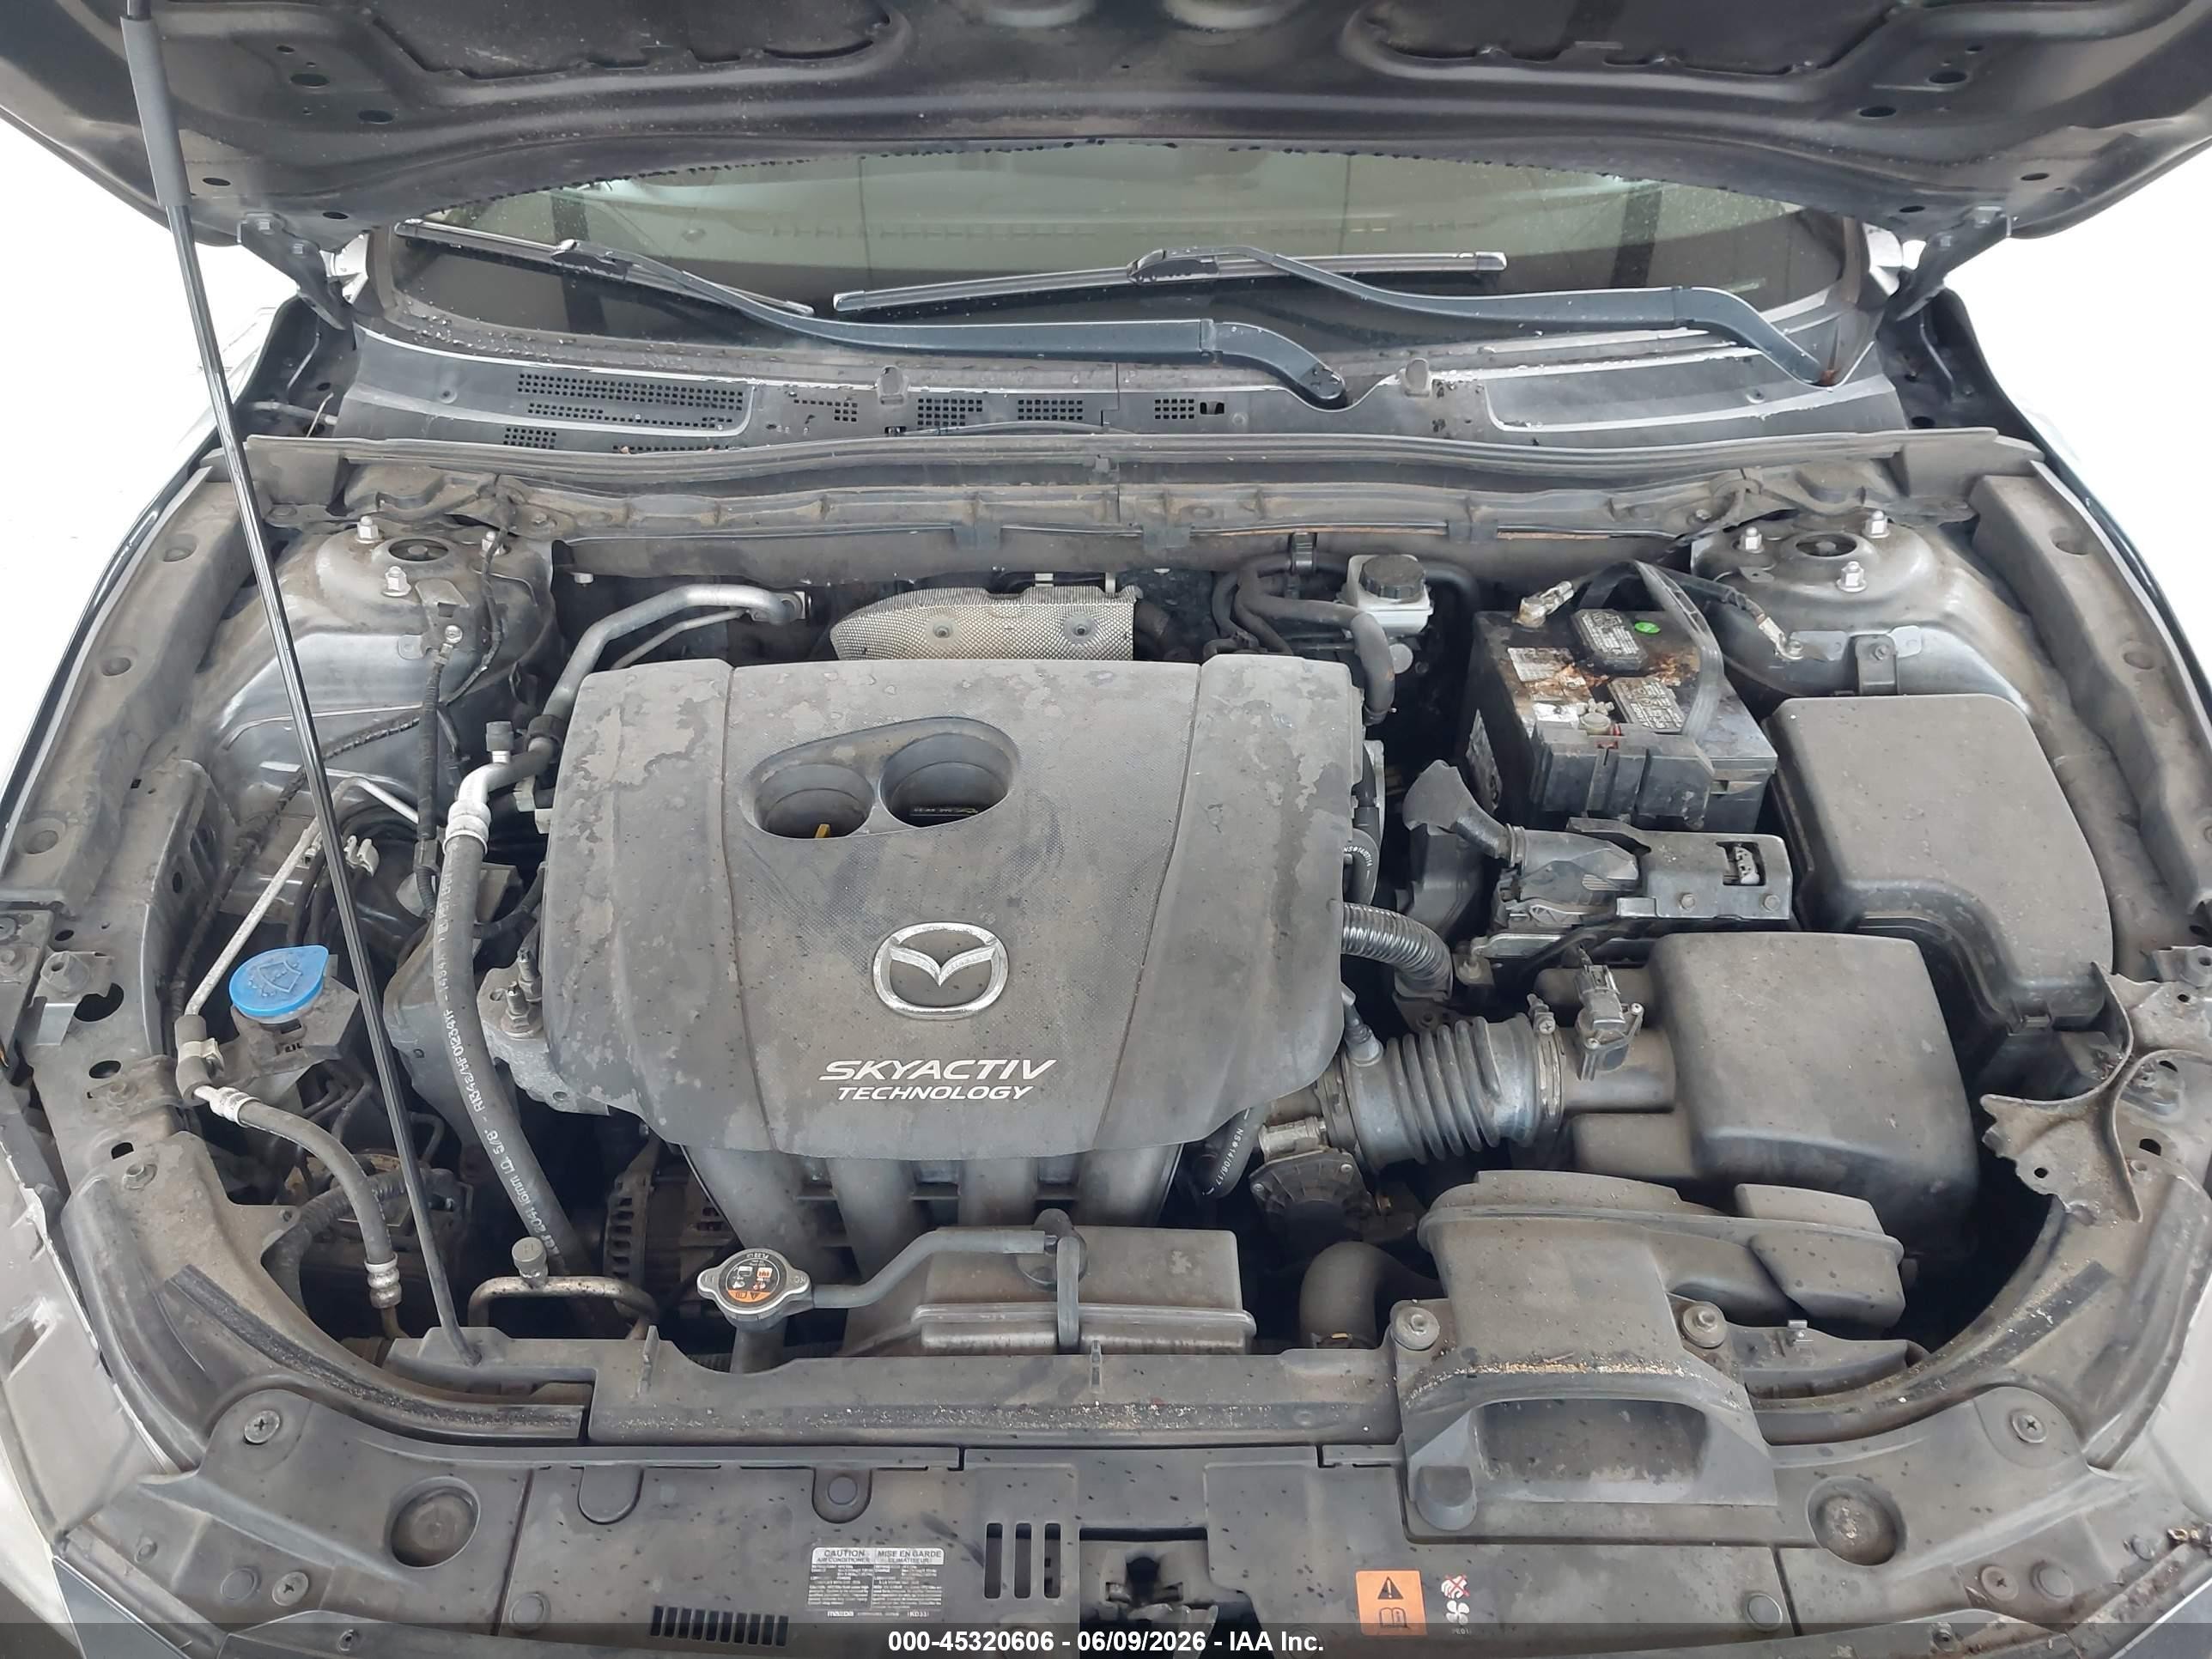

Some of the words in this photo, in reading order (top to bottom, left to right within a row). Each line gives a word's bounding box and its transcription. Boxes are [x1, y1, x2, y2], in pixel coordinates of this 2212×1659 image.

[818, 1059, 1057, 1081] SKYACTIV
[837, 1085, 1034, 1100] TECHNOLOGY
[878, 1549, 897, 1558] MISE
[900, 1549, 911, 1558] EN
[912, 1549, 942, 1558] GARDE
